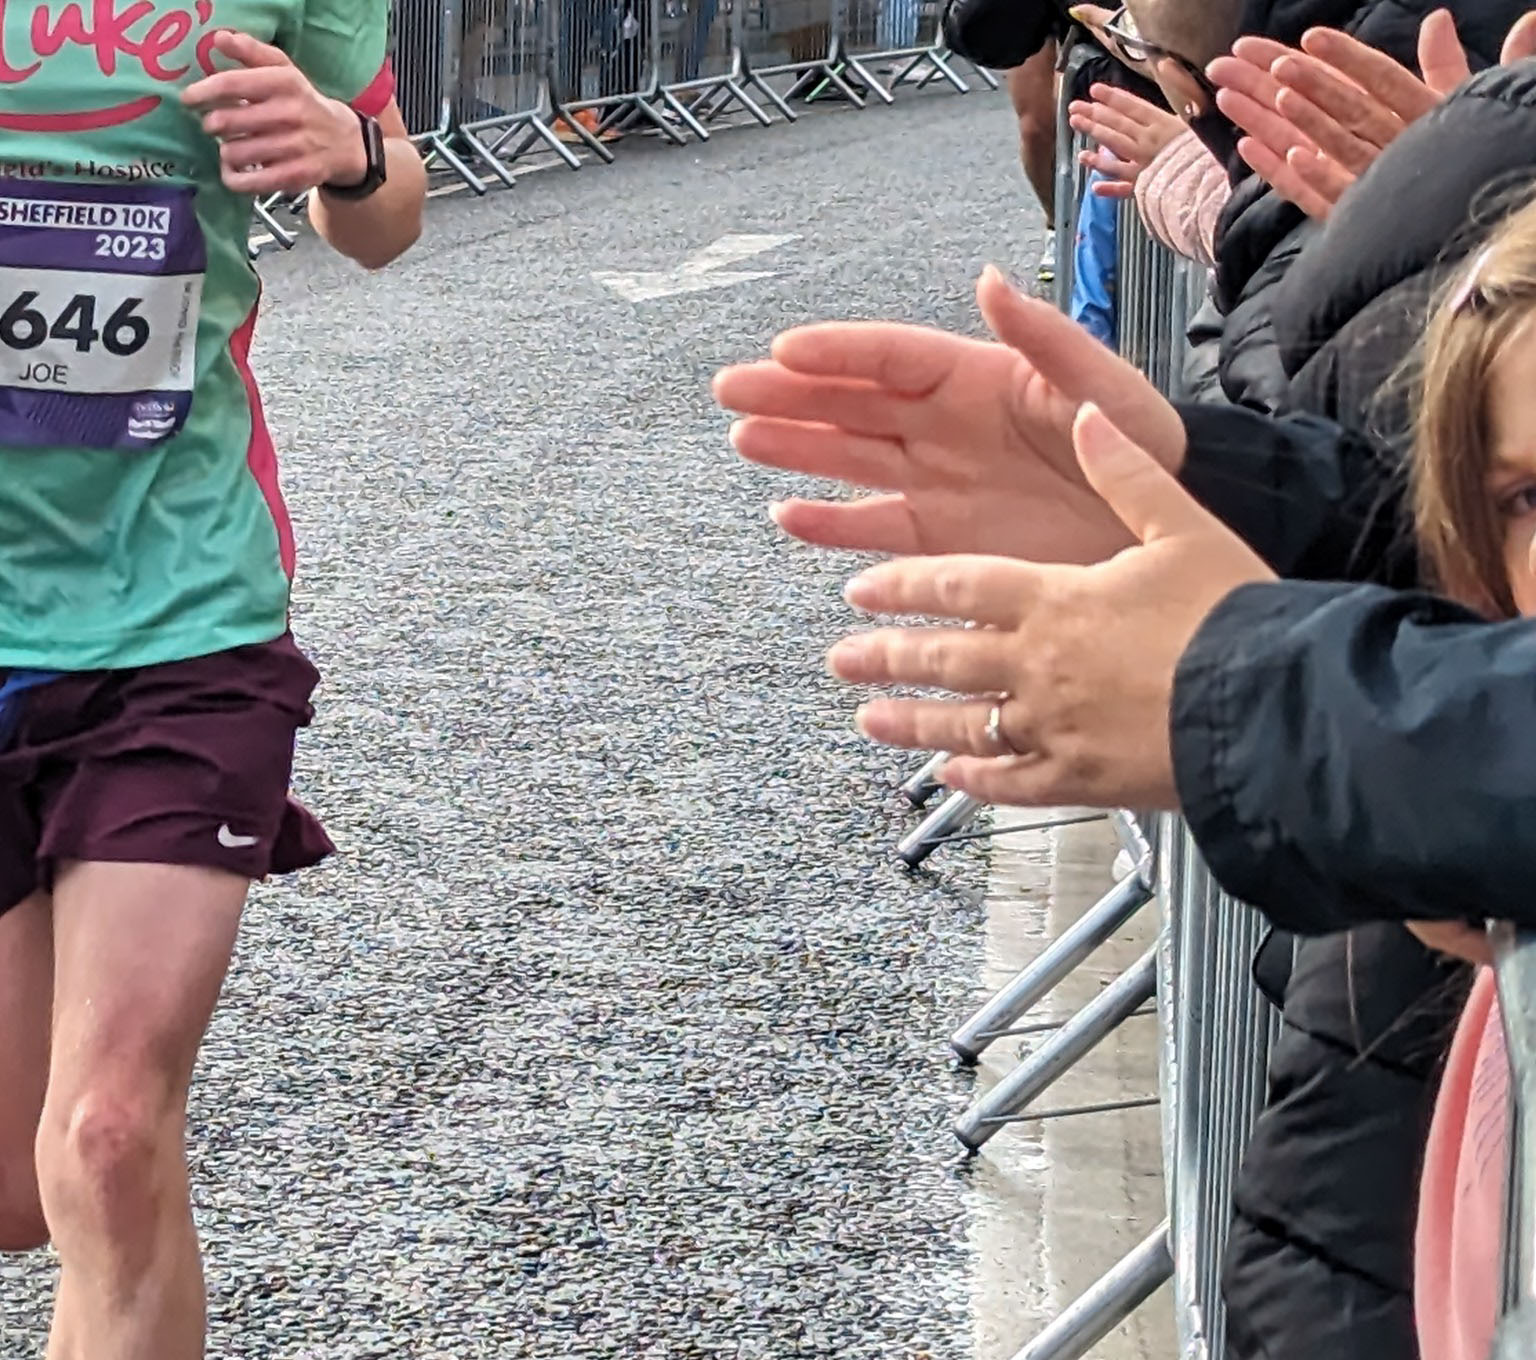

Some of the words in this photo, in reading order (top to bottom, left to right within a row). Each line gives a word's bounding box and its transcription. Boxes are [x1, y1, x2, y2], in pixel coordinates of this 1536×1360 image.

[75, 157, 175, 181] Hospice
[122, 207, 166, 231] 10K
[95, 233, 166, 261] 2023
[19, 362, 68, 385] JOE
